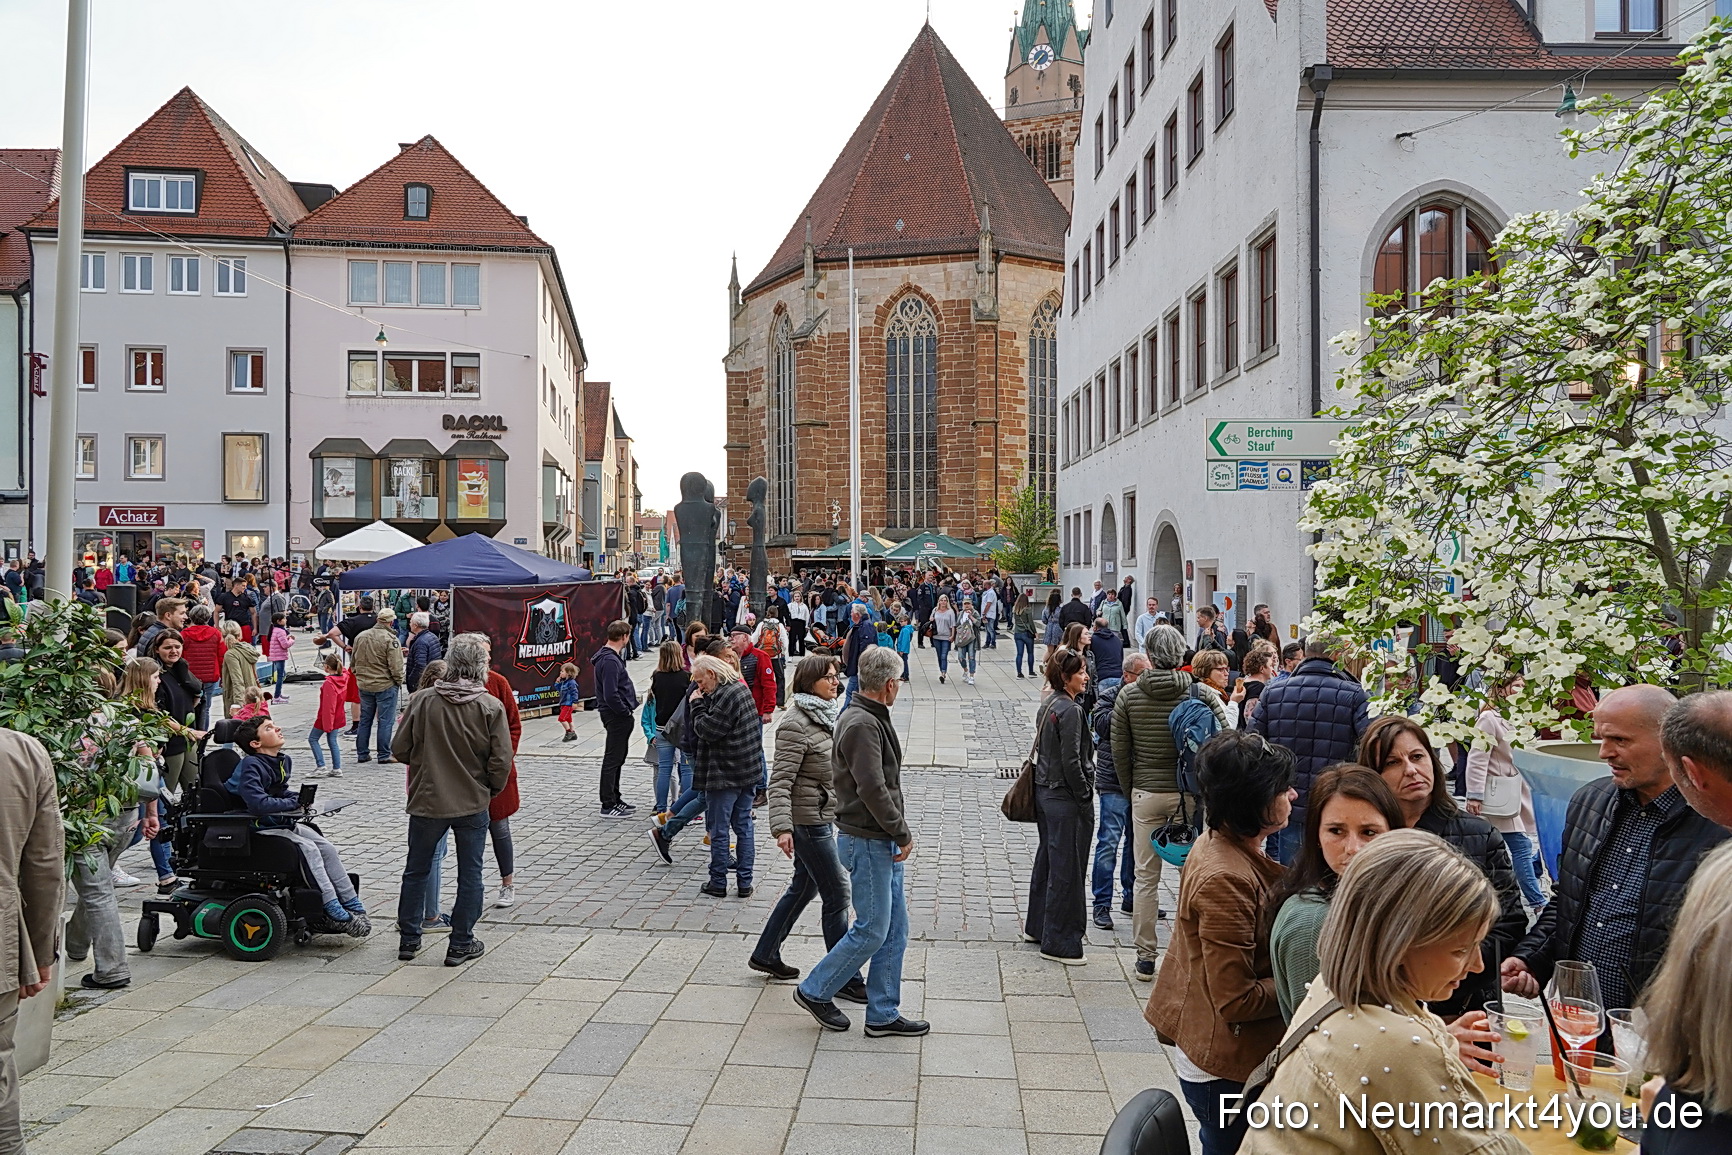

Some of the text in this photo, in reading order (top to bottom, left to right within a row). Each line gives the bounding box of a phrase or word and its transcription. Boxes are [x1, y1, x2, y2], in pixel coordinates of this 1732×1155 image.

[442, 414, 508, 431] RACKL
[466, 431, 501, 440] Rathaus
[1247, 426, 1293, 440] Berching
[1247, 441, 1275, 452] Stauf
[393, 466, 414, 477] RACKL
[1215, 471, 1230, 481] Sm
[104, 507, 158, 525] Achatz
[518, 639, 573, 659] NEUMARKT
